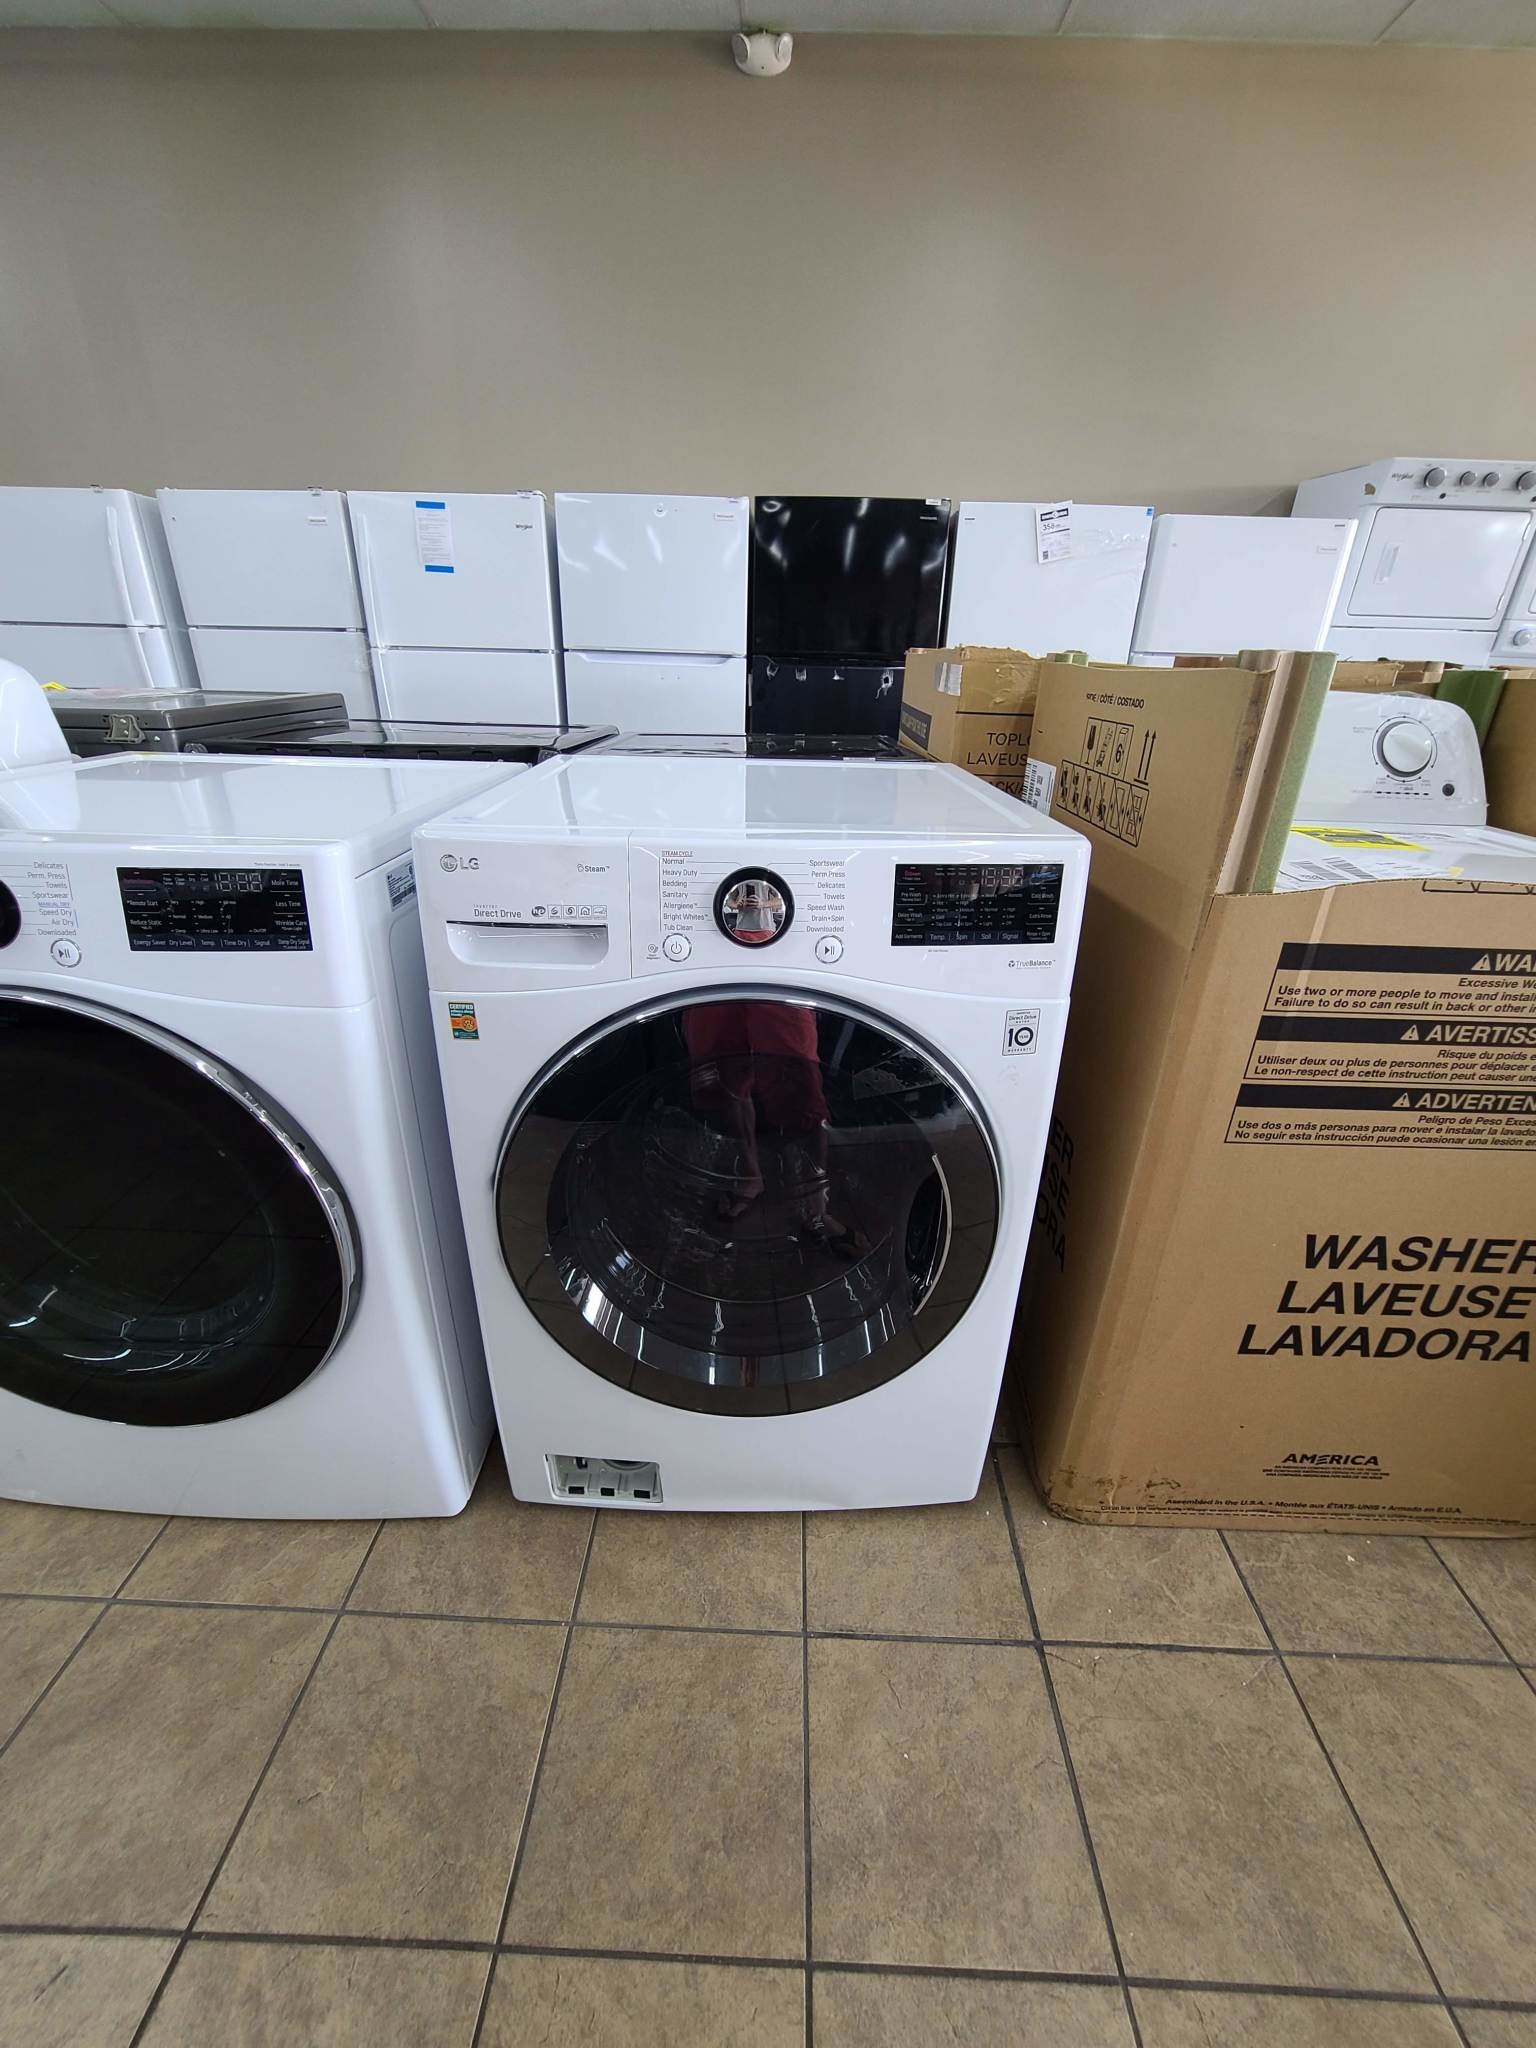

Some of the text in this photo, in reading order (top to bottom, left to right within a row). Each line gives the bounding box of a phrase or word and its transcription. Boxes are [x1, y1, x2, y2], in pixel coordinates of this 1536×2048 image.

[1117, 696, 1145, 709] COSTADO
[33, 861, 64, 869] Delicates
[683, 869, 698, 877] Duty
[45, 881, 68, 889] Towels
[662, 880, 687, 888] Bedding
[39, 908, 72, 917] Speed Dry
[474, 909, 521, 918] Direct Drive
[62, 918, 74, 926] Dry
[37, 929, 77, 937] Downloaded
[1458, 977, 1518, 989] Excessive
[1278, 985, 1301, 996] Use
[1304, 986, 1326, 996] two
[1330, 988, 1344, 996] or
[1345, 989, 1377, 998] more
[1379, 989, 1421, 1000] people
[1424, 990, 1436, 999] to
[1439, 991, 1472, 1000] move
[1475, 991, 1499, 1001] and
[1274, 997, 1315, 1007] Failure
[1318, 998, 1330, 1008] to
[1333, 999, 1349, 1008] do
[1369, 1001, 1391, 1009] can
[1394, 1001, 1430, 1010] result
[1432, 1001, 1443, 1011] in
[1445, 1001, 1475, 1012] back
[1478, 1004, 1491, 1012] or
[1494, 1003, 1527, 1013] other
[1008, 1026, 1034, 1047] 10
[1424, 1024, 1536, 1045] AVERTISS
[1437, 1049, 1528, 1062] Risque du poids
[1257, 1054, 1529, 1072] Utiliser deux ou plus de personnes pour déplacer
[1254, 1065, 1268, 1075] Le
[1270, 1066, 1338, 1078] non-respect
[1340, 1067, 1355, 1077] de
[1357, 1068, 1386, 1078] cette
[1388, 1069, 1448, 1079] instruction
[1450, 1071, 1476, 1081] peut
[1478, 1073, 1517, 1081] causer
[1414, 1092, 1536, 1111] ADVERTEN
[1417, 1114, 1456, 1126] Peligro
[1458, 1116, 1473, 1125] de
[1475, 1116, 1502, 1126] Peso
[1237, 1120, 1259, 1129] Use
[1261, 1120, 1281, 1130] dos
[1293, 1121, 1317, 1130] más
[1319, 1123, 1371, 1132] personas
[1371, 1125, 1397, 1134] para
[1398, 1126, 1432, 1134] mover
[1445, 1125, 1486, 1135] instalar
[1487, 1127, 1499, 1136] la
[1500, 1127, 1536, 1137] lavado
[1234, 1130, 1250, 1139] No
[1252, 1131, 1287, 1141] seguir
[1289, 1131, 1312, 1140] esta
[1314, 1132, 1374, 1142] instrucción
[1375, 1134, 1410, 1144] puede
[1412, 1135, 1467, 1144] ocasionar
[1468, 1137, 1489, 1145] una
[1491, 1136, 1523, 1146] lesión
[1305, 1234, 1536, 1274] WASHER
[1277, 1281, 1536, 1319] LAVEUSE
[1237, 1324, 1531, 1362] LAVADORA
[1281, 1453, 1380, 1466] AMERICA
